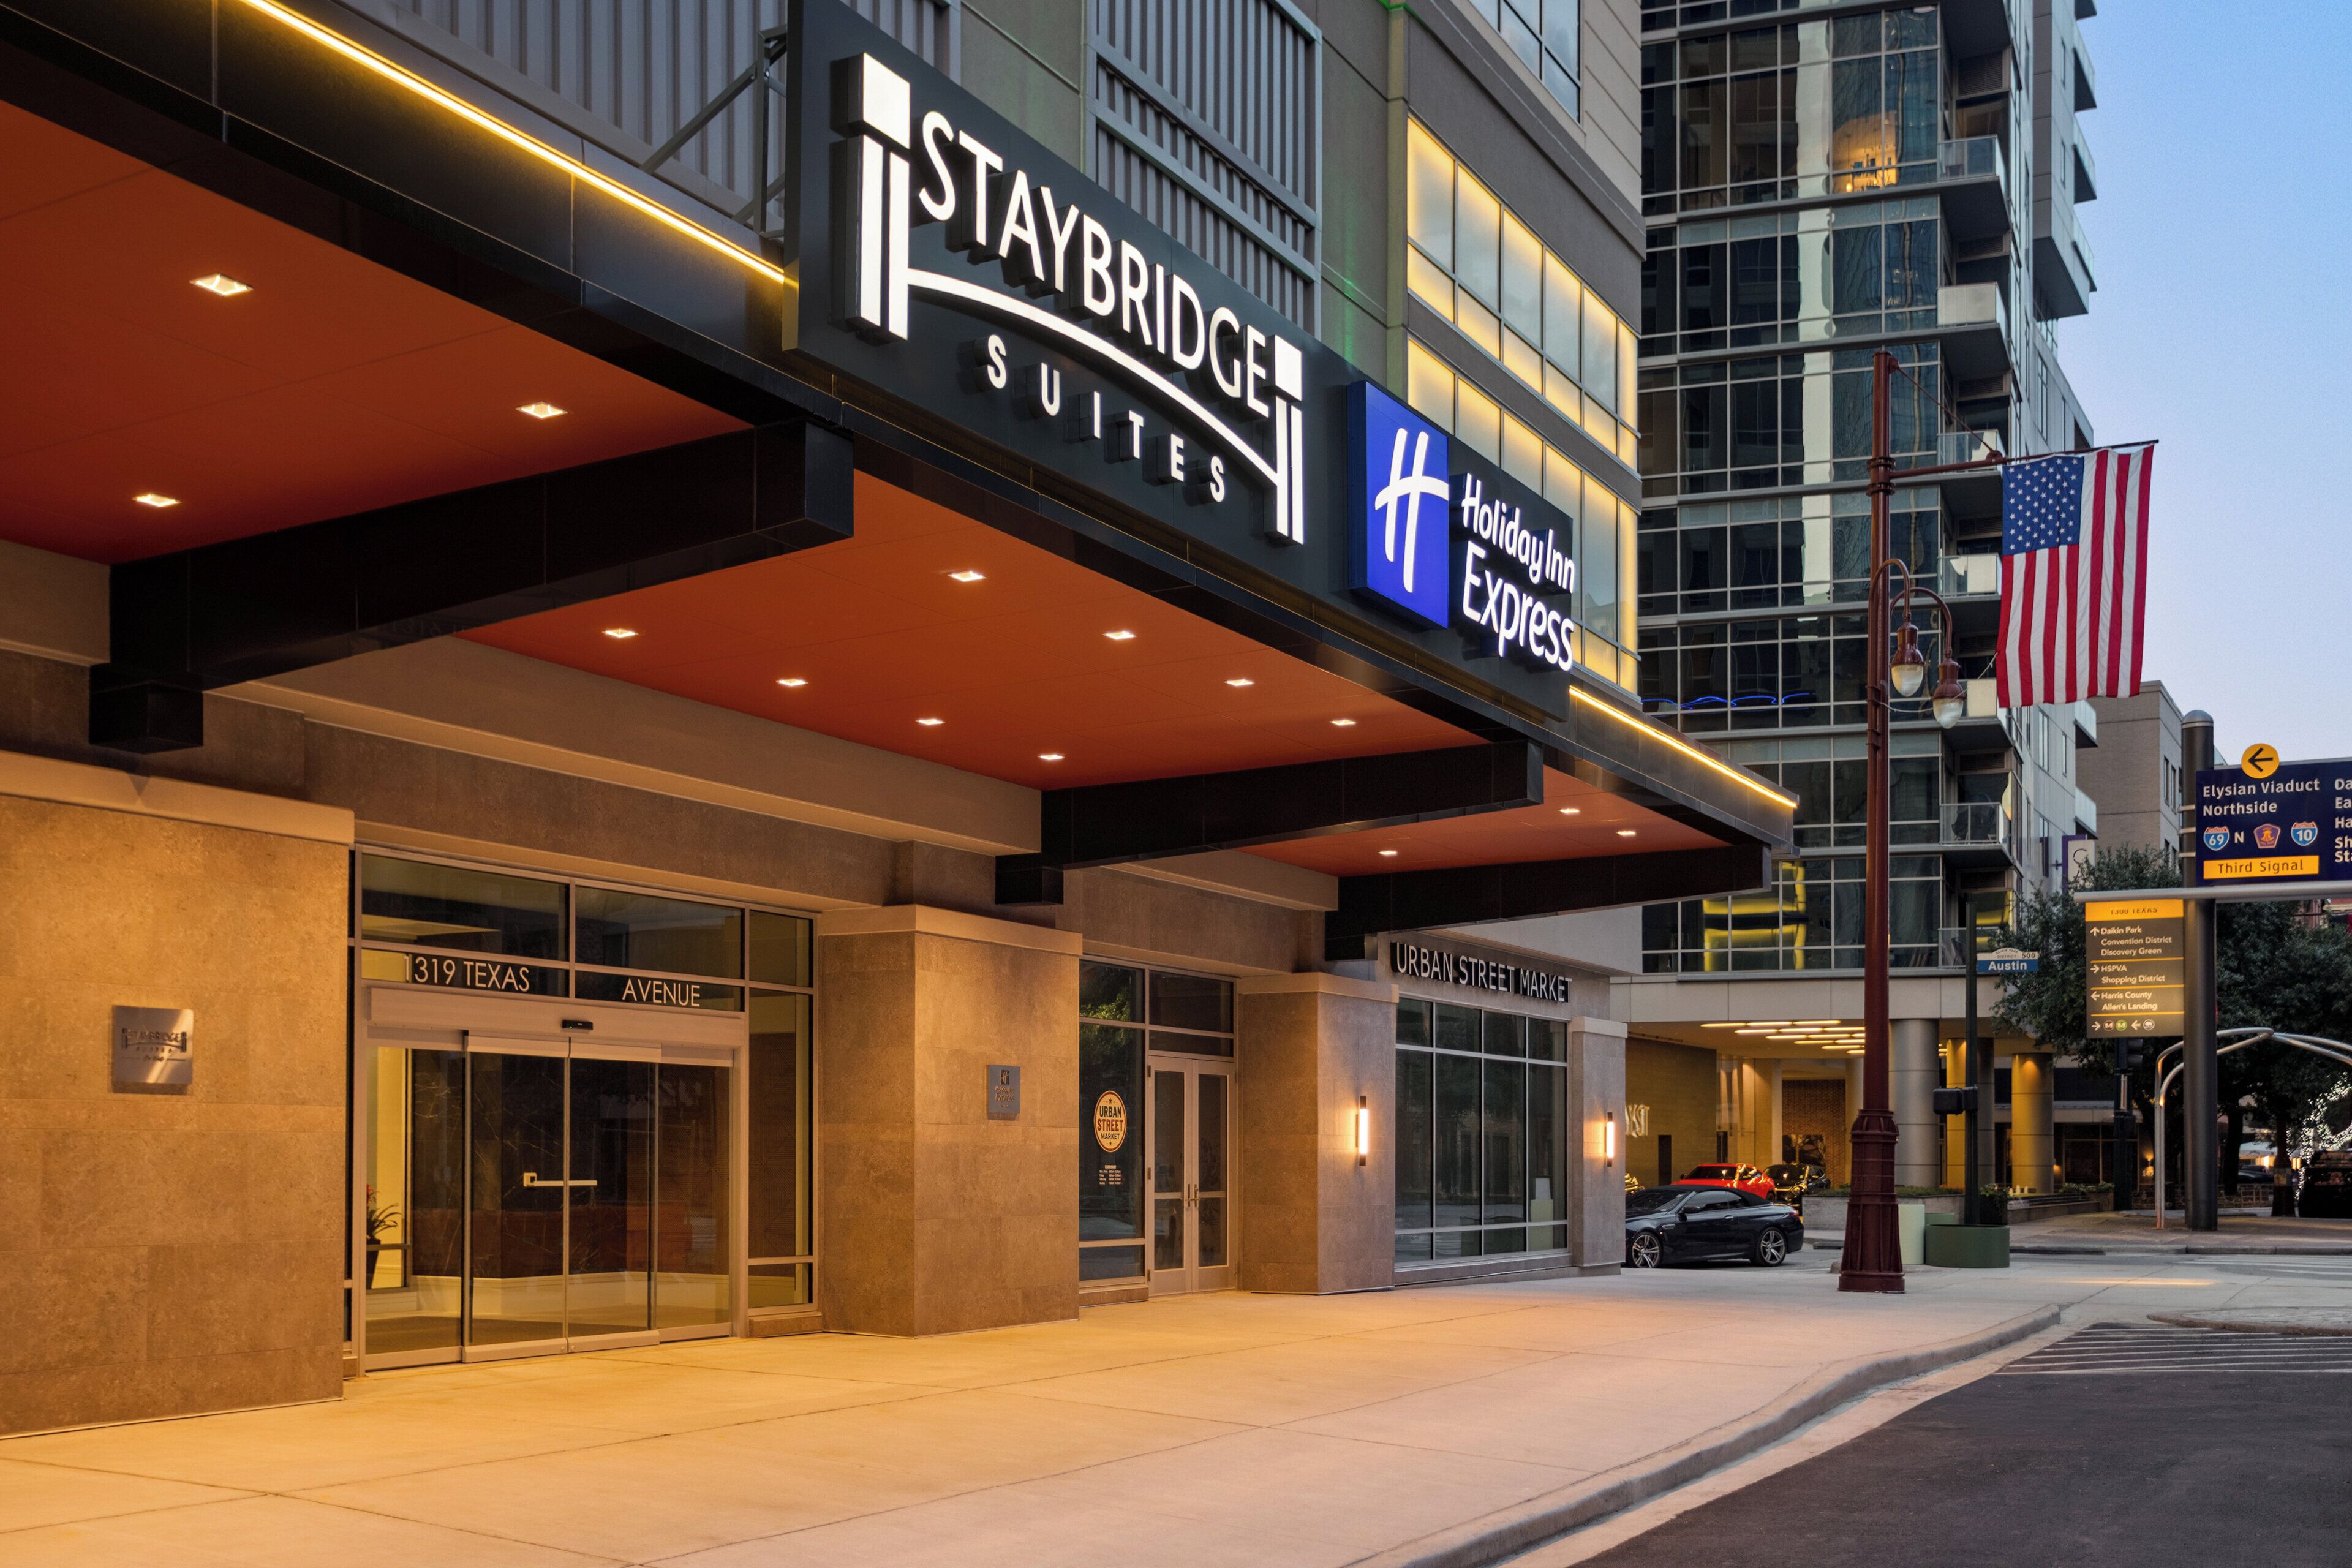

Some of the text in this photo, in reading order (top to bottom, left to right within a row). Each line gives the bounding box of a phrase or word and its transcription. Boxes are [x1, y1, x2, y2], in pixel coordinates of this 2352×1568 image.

[919, 111, 1270, 419] STAYBRIDGE
[987, 334, 1225, 502] SUITES
[1461, 472, 1575, 594] Holiday Inn
[1462, 540, 1574, 672] Express
[2203, 778, 2320, 799] Elysian Viaduct
[2203, 801, 2277, 816] Northside
[2335, 797, 2352, 809] Ea
[2209, 829, 2313, 846] 69 N 10
[2335, 850, 2352, 863] St
[2218, 859, 2304, 874] Third Signal
[1396, 942, 1572, 1003] URBAN STREET MARKET
[1988, 961, 2027, 970] Austin
[404, 956, 700, 1007] 1319 TEXAS AVENUE
[1099, 1106, 1121, 1118] URBAN
[1097, 1118, 1123, 1132] STREET
